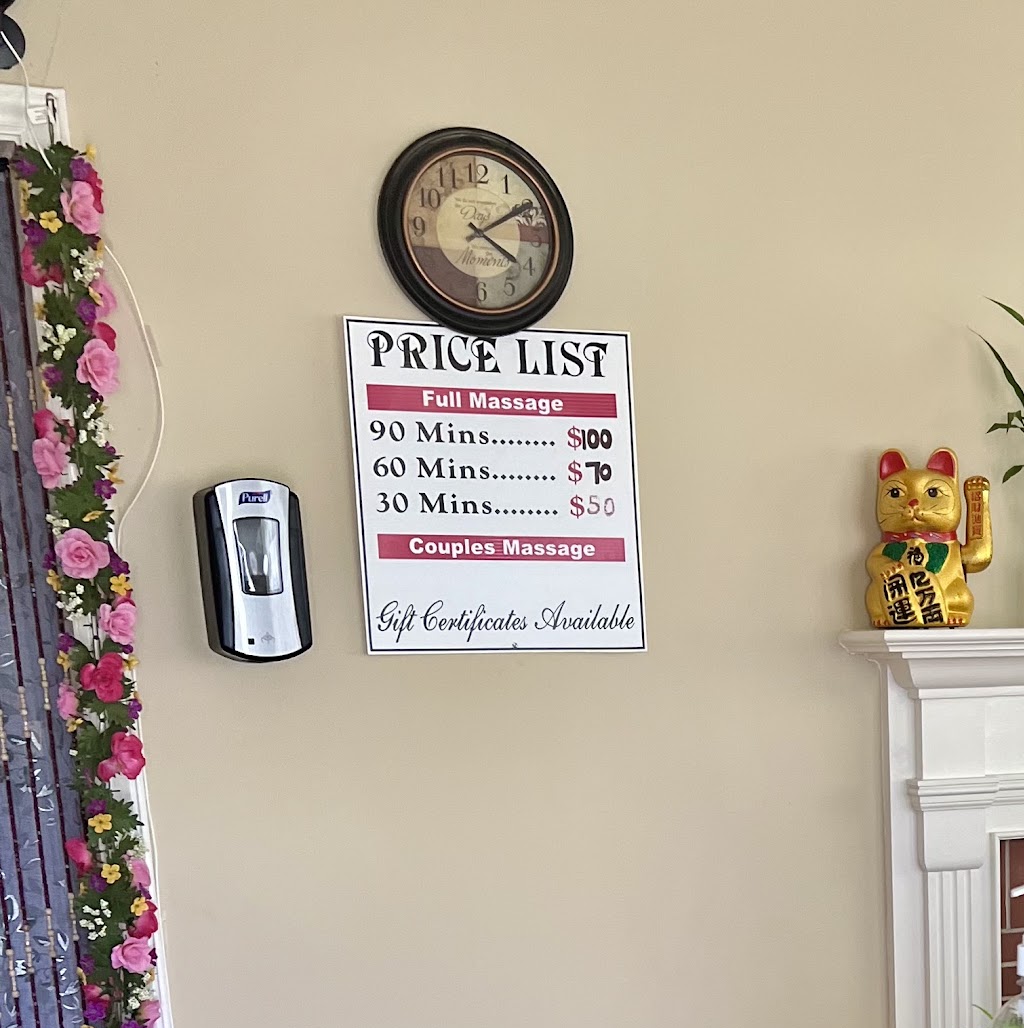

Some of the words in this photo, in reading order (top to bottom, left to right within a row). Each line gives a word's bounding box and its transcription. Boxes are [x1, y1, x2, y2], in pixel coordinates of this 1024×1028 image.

[438, 166, 458, 189] 11
[466, 162, 489, 184] 12
[500, 174, 511, 195] 1
[419, 187, 441, 209] 10
[412, 216, 426, 237] 9
[522, 257, 535, 276] 4
[476, 281, 487, 302] 6
[503, 277, 516, 297] 5
[366, 330, 502, 373] PRICE
[515, 338, 609, 378] LIST
[421, 390, 462, 408] Full
[469, 392, 564, 414] Massage
[369, 420, 405, 442] 90
[567, 426, 613, 451] $100
[373, 456, 406, 478] 60
[567, 460, 612, 485] $70
[241, 492, 268, 503] Purell
[376, 492, 409, 514] 30
[570, 494, 616, 519] $50
[409, 537, 495, 558] Couples
[502, 539, 596, 559] Massage
[376, 600, 414, 642] Gift
[420, 600, 528, 642] Certificates
[534, 600, 635, 631] Available
